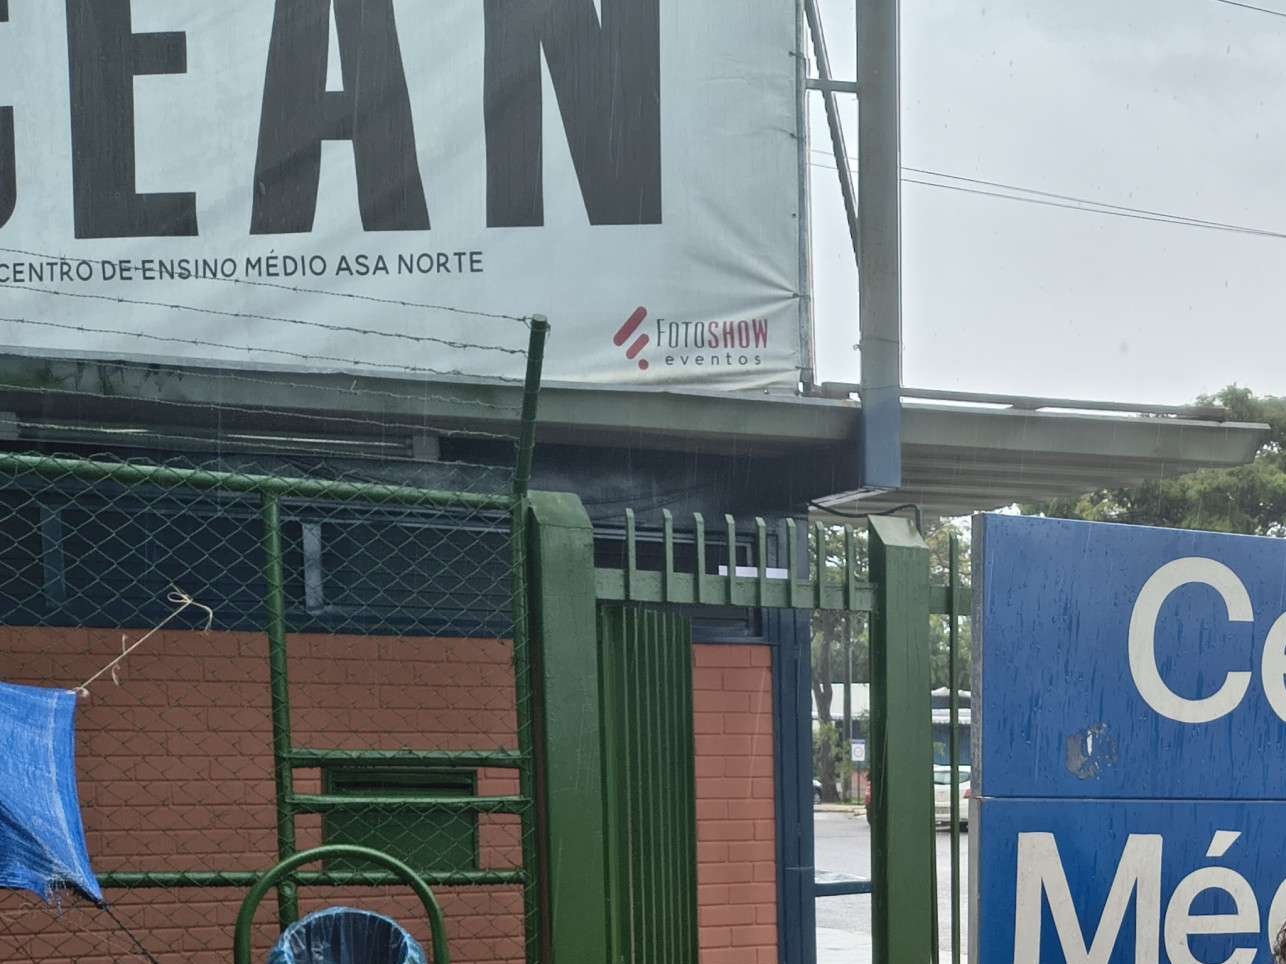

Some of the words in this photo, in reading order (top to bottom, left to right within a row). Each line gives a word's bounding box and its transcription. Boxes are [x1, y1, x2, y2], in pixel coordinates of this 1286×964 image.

[0, 0, 663, 239] EAN
[0, 260, 94, 283] CENTRO
[101, 259, 134, 282] DE
[142, 257, 238, 281] ENSINO
[245, 249, 327, 278] MÉDIO
[335, 254, 390, 277] ASA
[397, 250, 484, 275] NORTE
[664, 351, 762, 367] eventos
